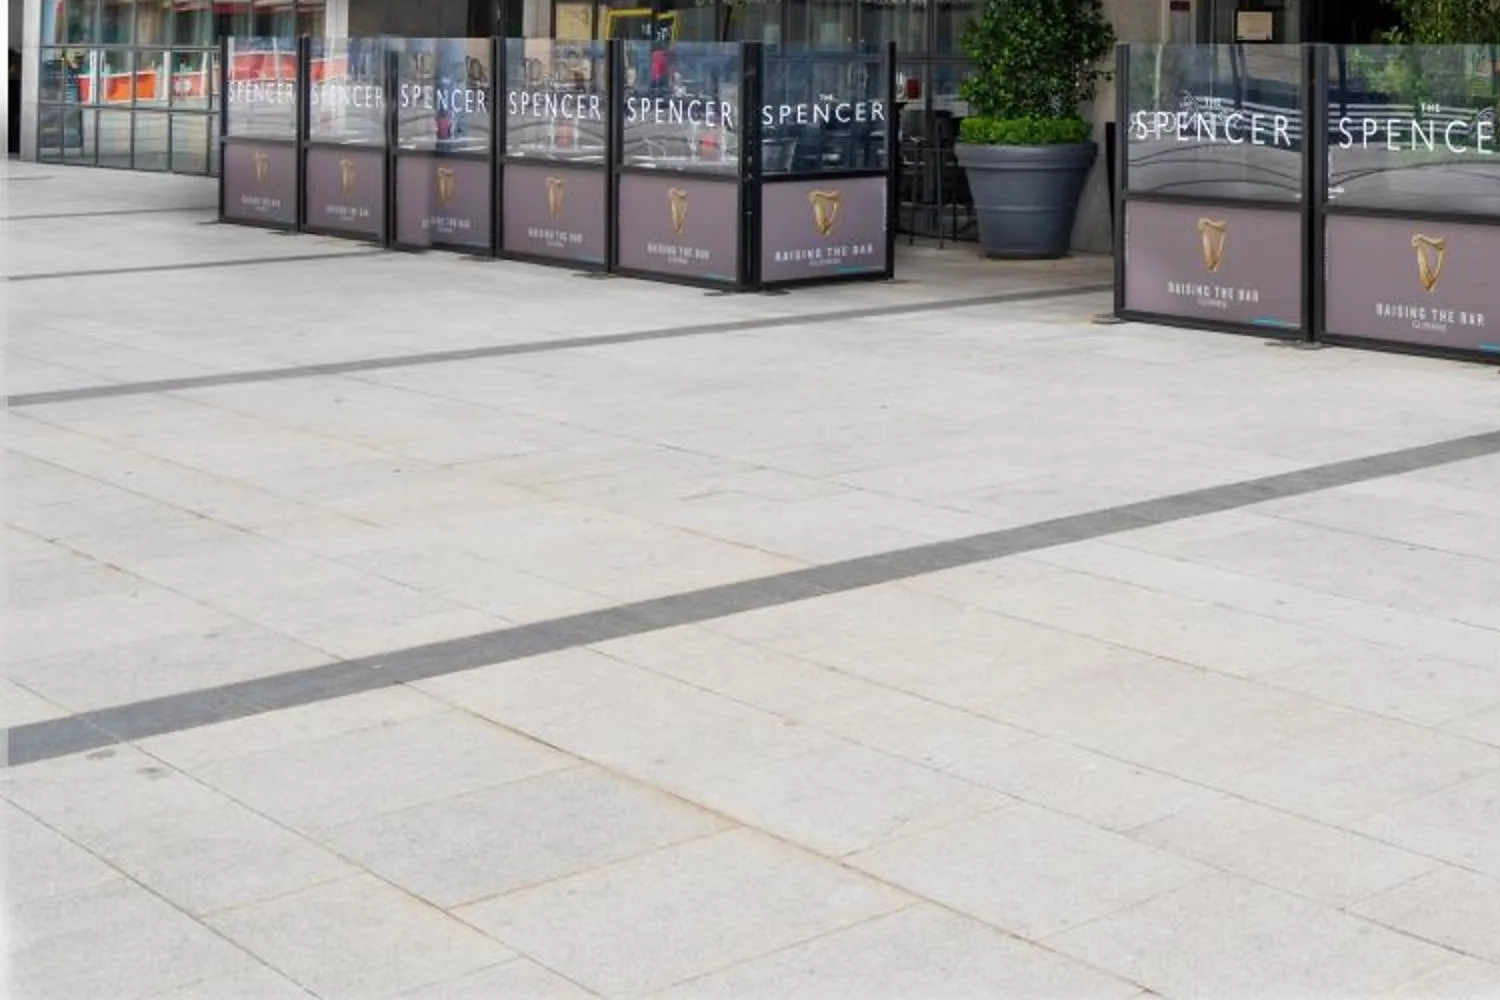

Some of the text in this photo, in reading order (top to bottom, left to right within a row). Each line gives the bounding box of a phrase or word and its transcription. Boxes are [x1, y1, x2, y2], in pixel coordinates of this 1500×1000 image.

[401, 84, 488, 113] SPENCER
[509, 91, 601, 120] SPENCER
[1420, 103, 1441, 113] THE
[627, 97, 733, 128] SPENCER
[762, 103, 885, 126] SPENCER
[1136, 109, 1291, 146] SPENCER
[1215, 286, 1234, 300] THE
[1375, 302, 1486, 328] RAISING THE BAR
